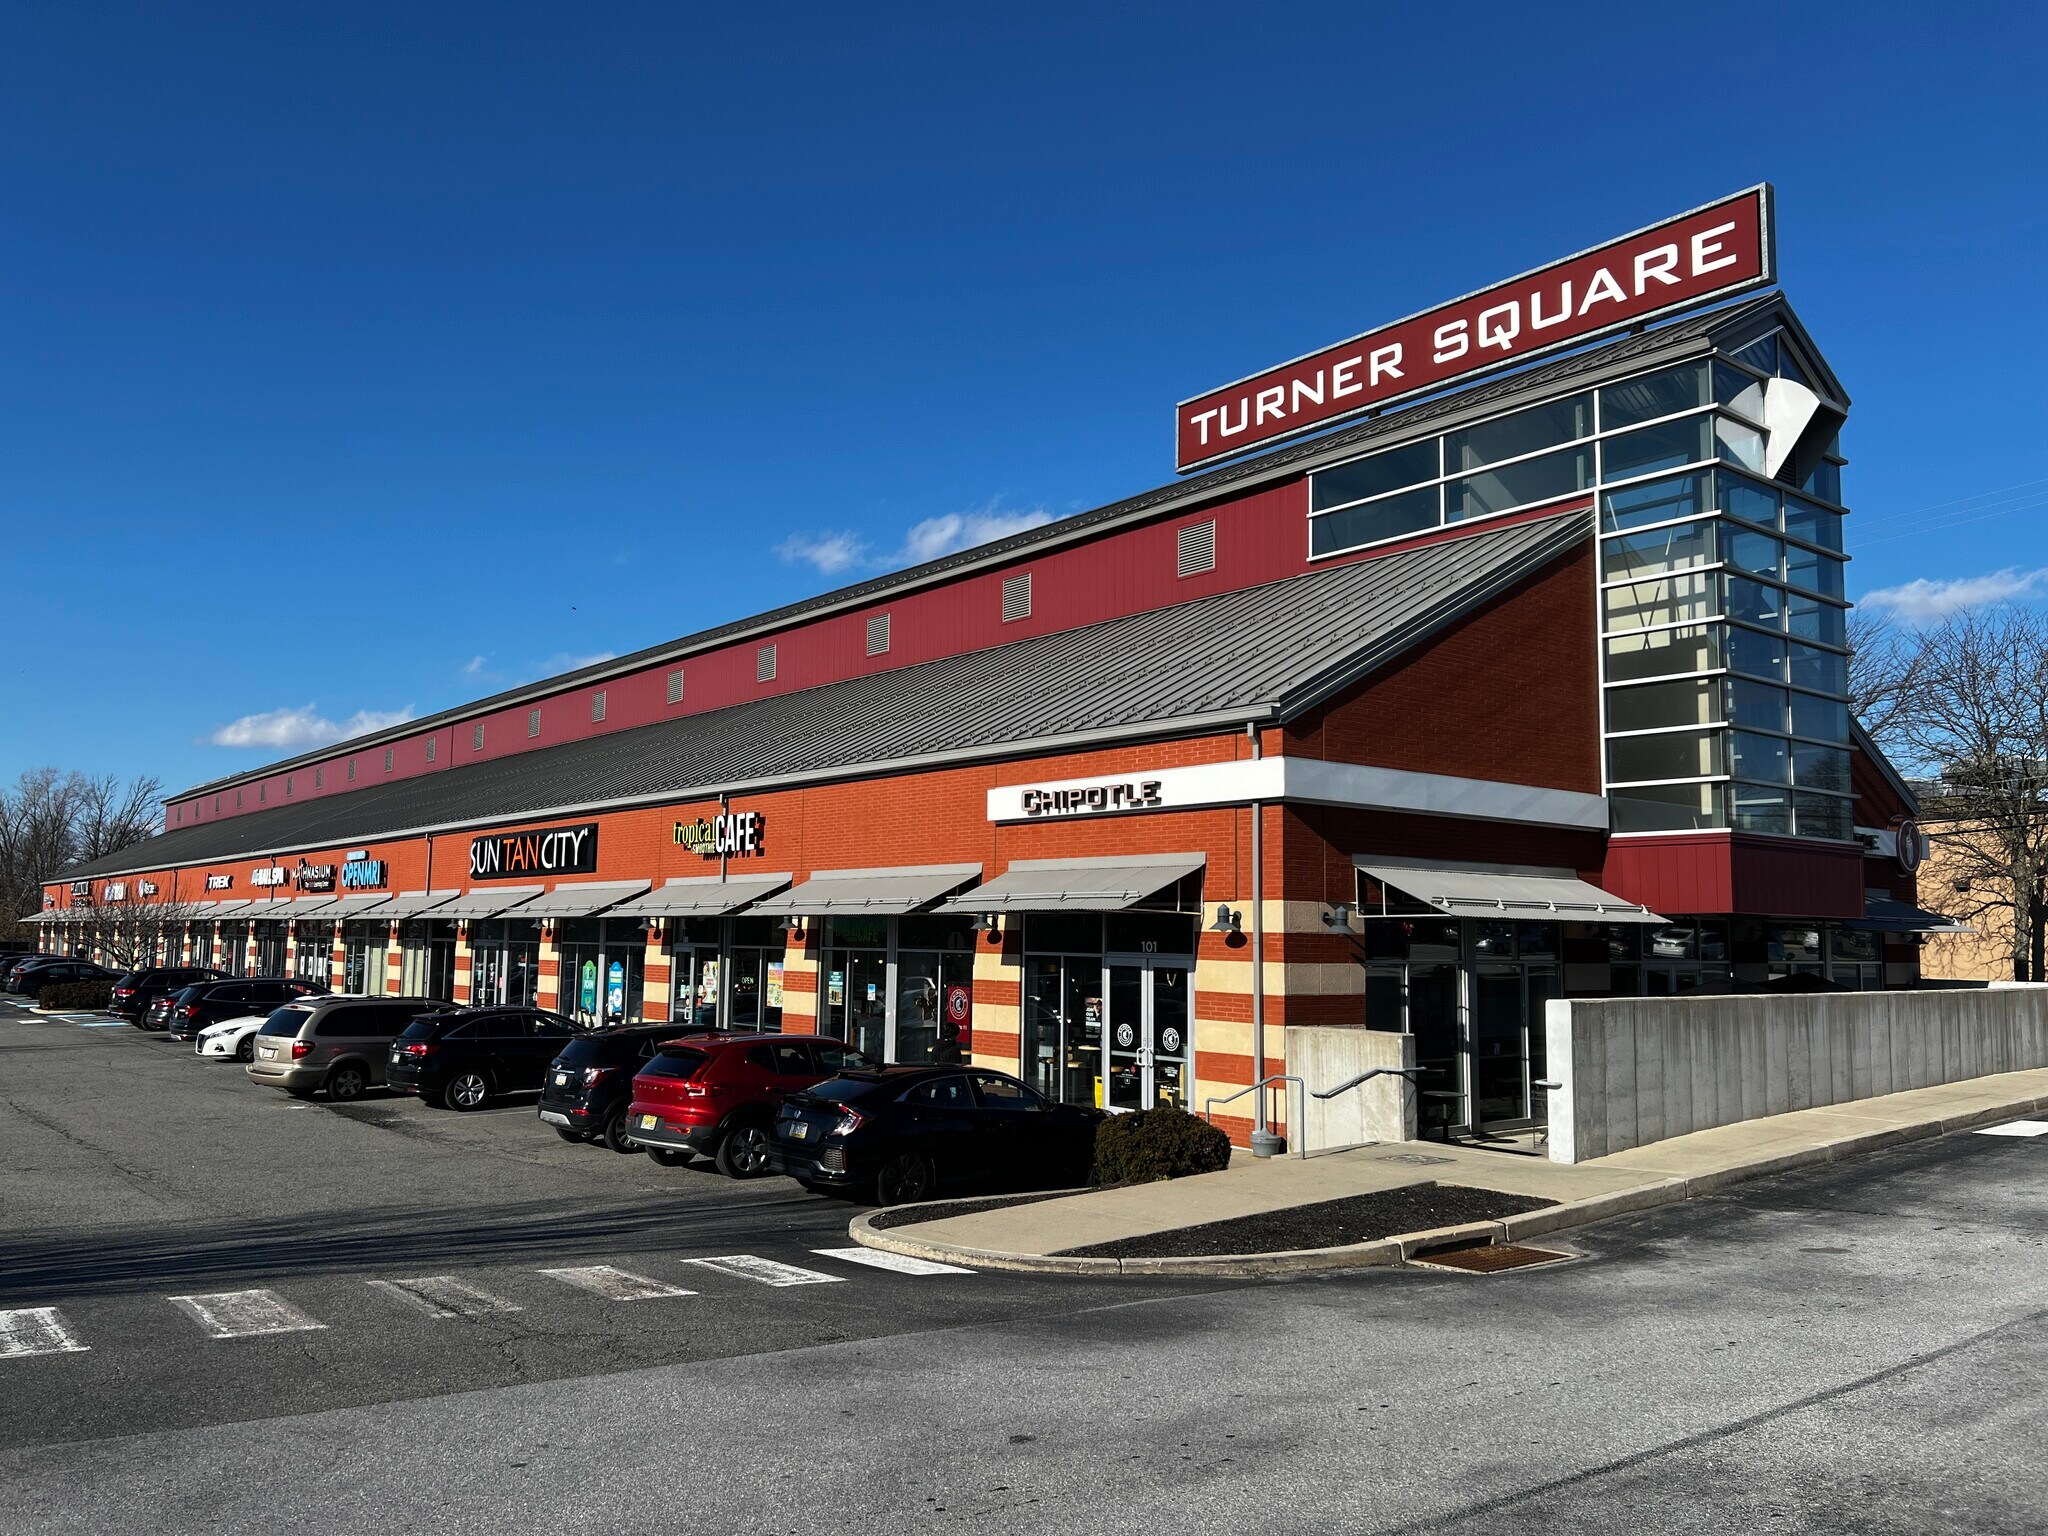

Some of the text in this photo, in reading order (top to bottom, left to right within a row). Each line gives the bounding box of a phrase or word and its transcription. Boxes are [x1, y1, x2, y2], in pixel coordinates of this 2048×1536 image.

[1190, 220, 1738, 446] TURNER SQUARE
[1020, 780, 1160, 814] CHIPOTLE
[672, 811, 756, 853] tropical CAFE
[469, 829, 586, 874] SUN TAN CITY
[207, 875, 231, 889] TREK
[291, 862, 332, 881] MATHNASIUM
[1140, 941, 1158, 953] 101
[741, 976, 754, 985] OPEN
